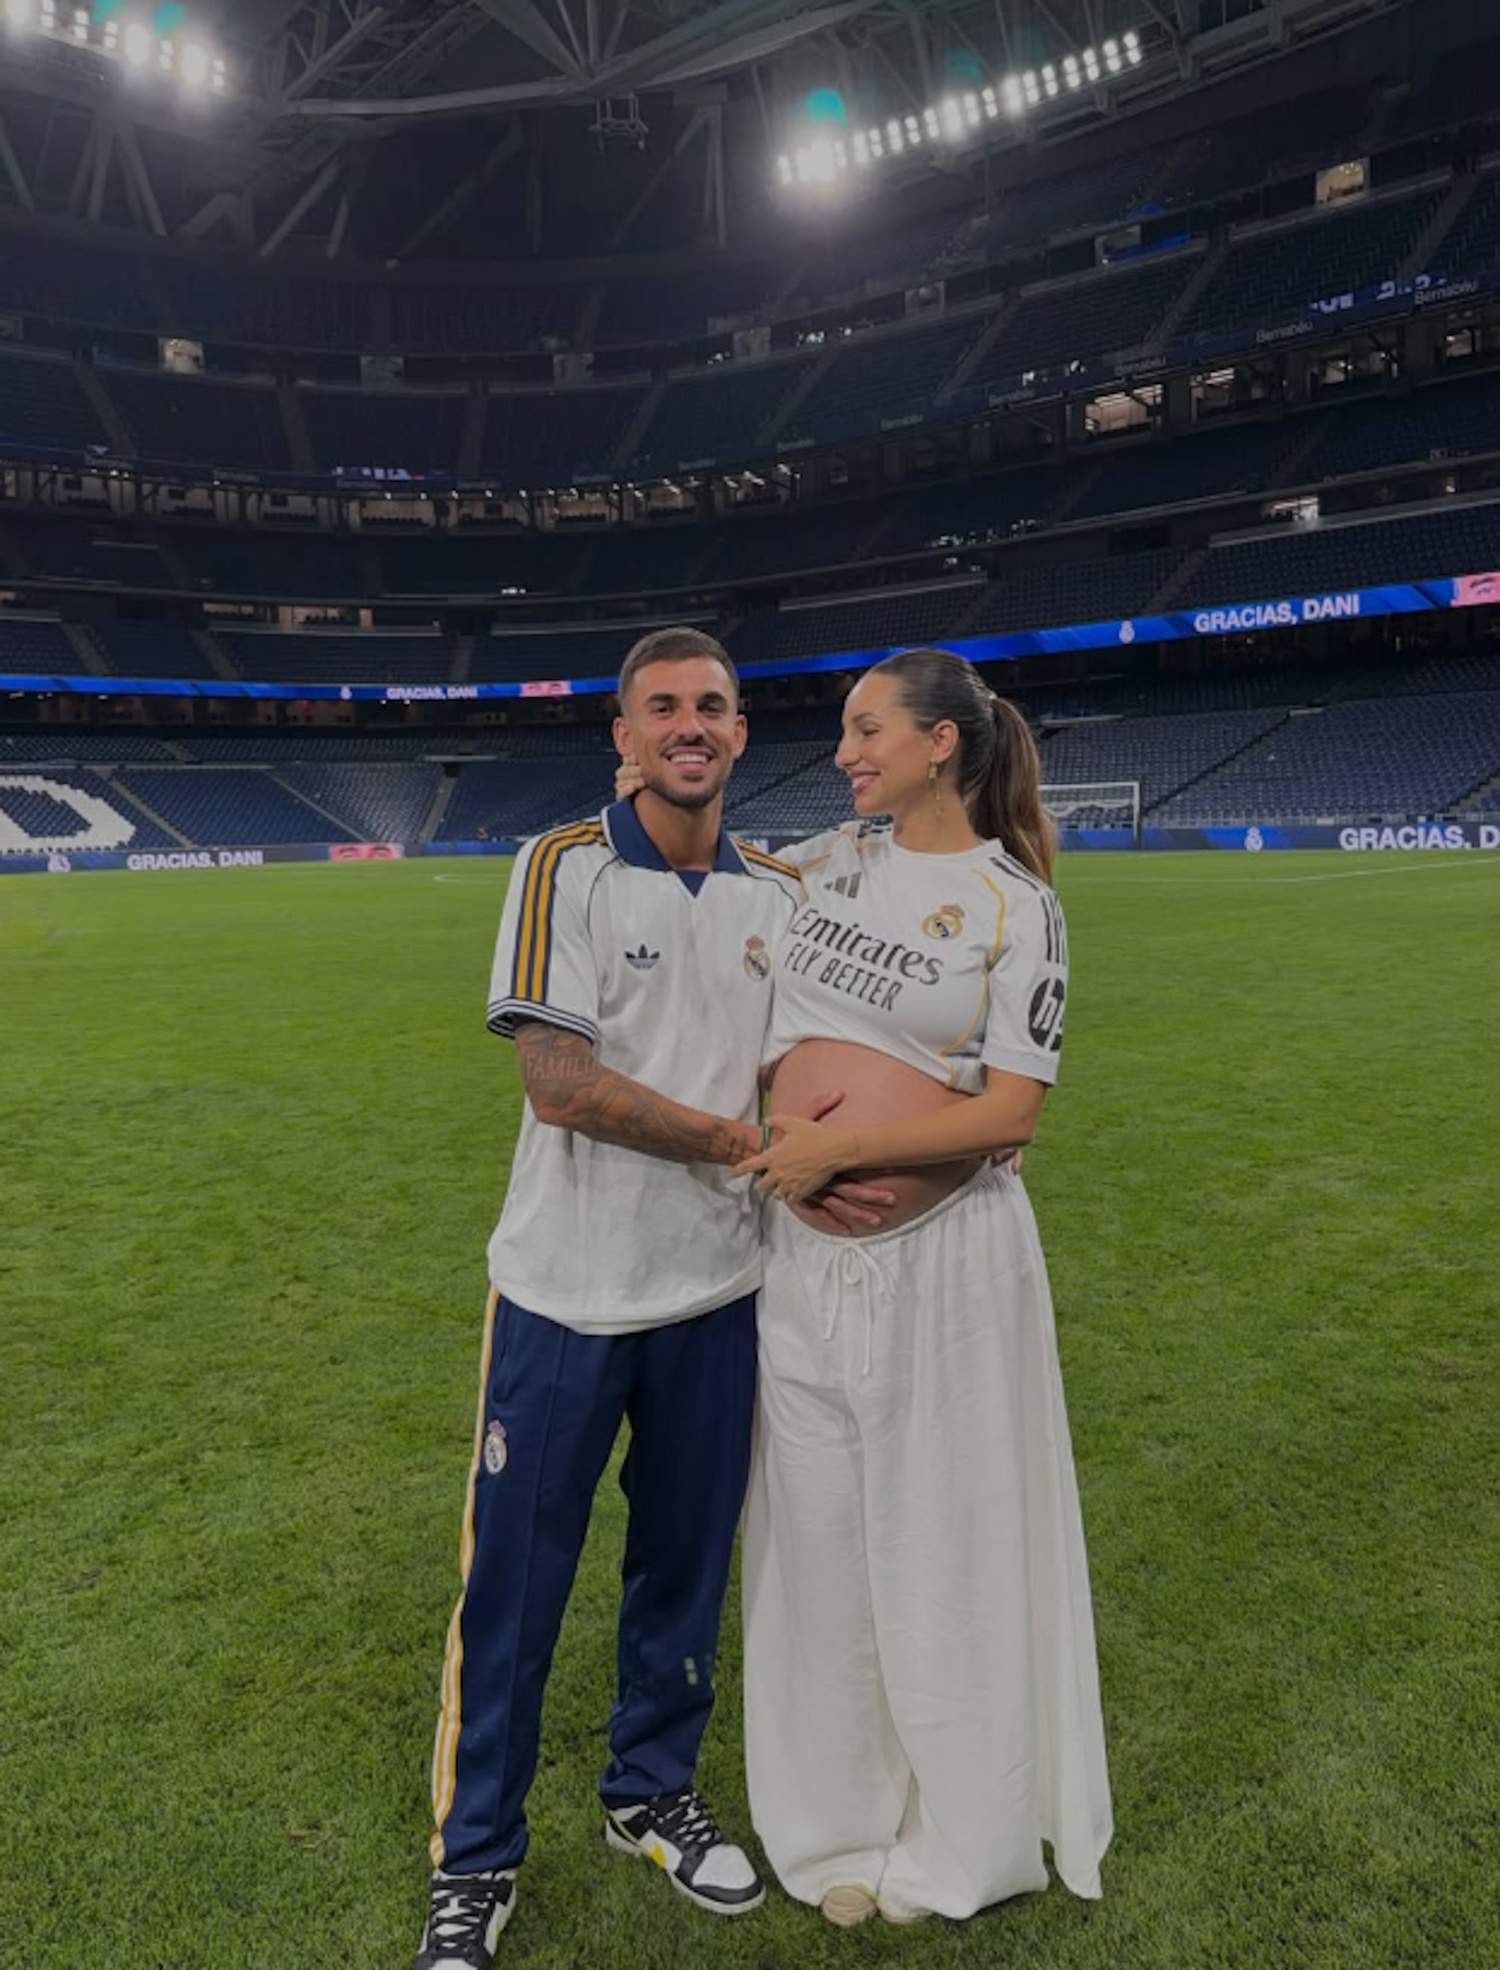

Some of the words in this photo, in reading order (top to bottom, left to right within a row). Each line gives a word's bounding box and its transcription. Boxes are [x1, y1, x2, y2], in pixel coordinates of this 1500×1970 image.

[1194, 602, 1297, 633] GRACIAS,
[1303, 594, 1360, 621] DANI
[218, 850, 264, 867] DANI
[790, 908, 943, 986] Emirates
[785, 942, 821, 975] FLY
[819, 957, 904, 1012] BETTER
